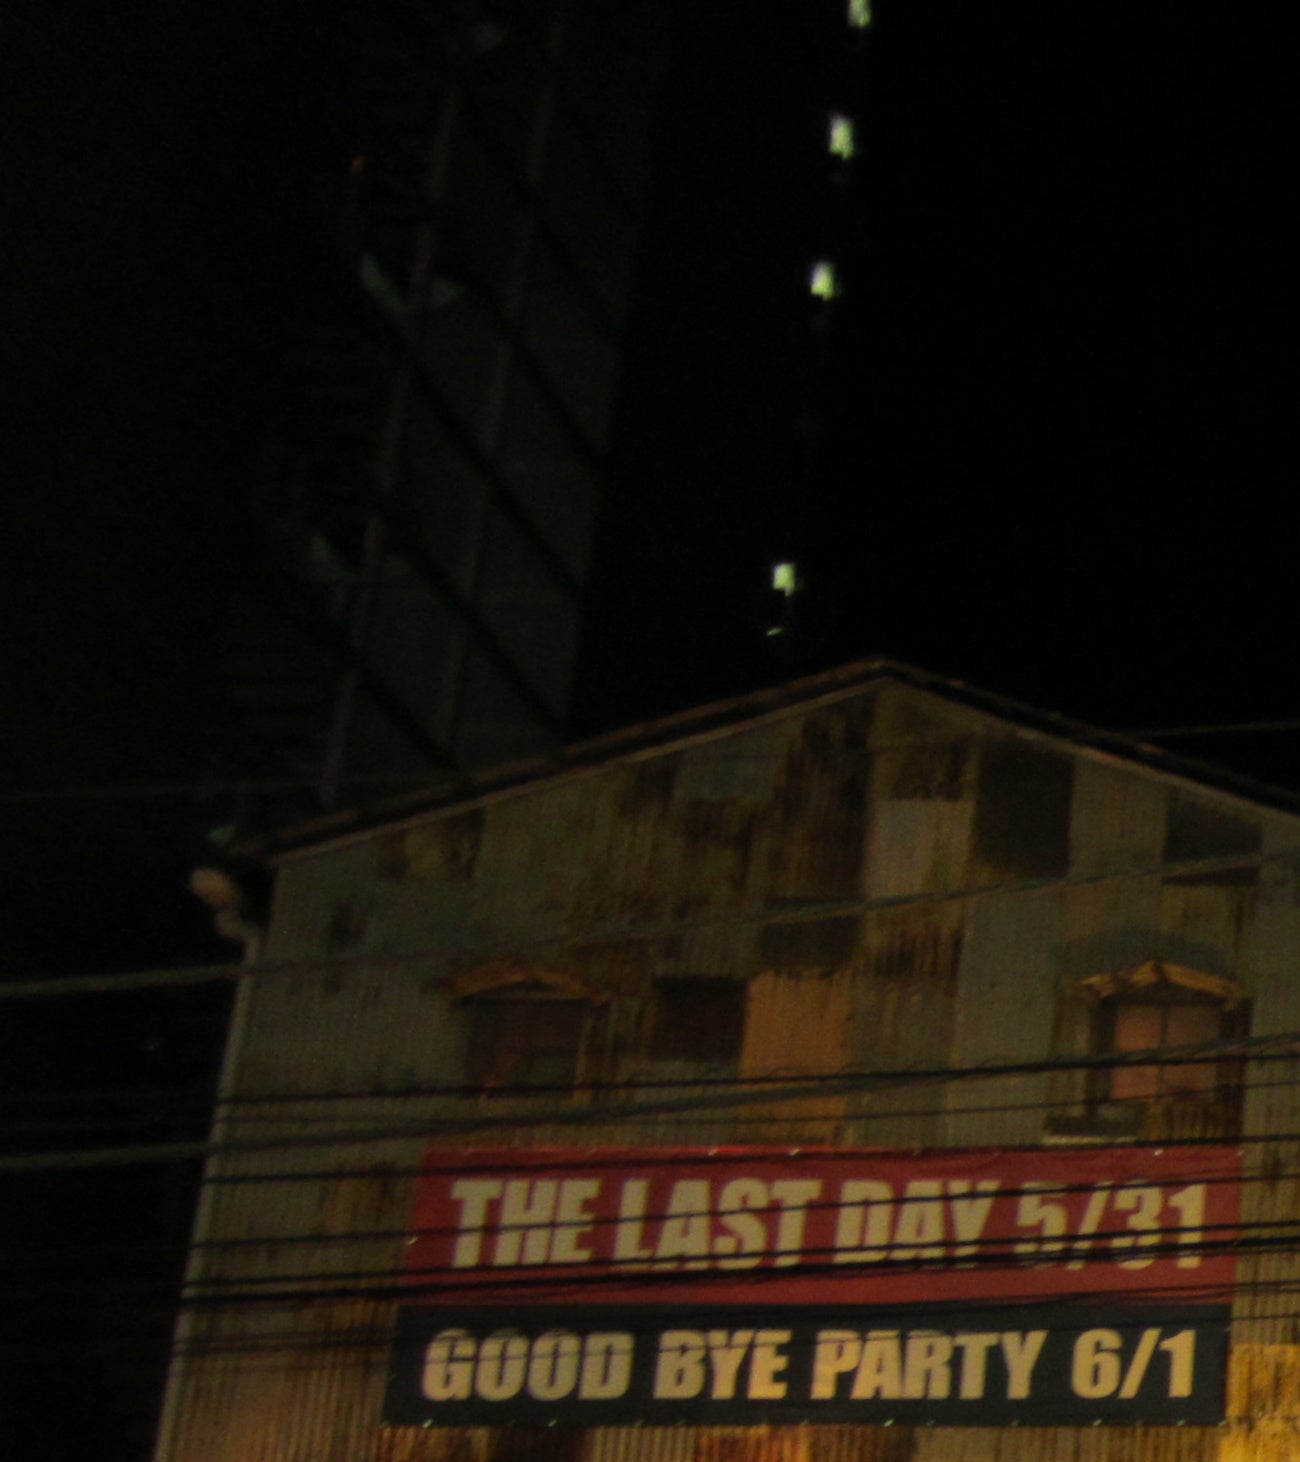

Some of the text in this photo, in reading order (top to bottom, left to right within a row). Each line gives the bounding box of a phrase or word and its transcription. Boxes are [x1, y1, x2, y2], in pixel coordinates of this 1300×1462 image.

[450, 1178, 1208, 1271] THE LAST DAY 5/31
[421, 1328, 1199, 1402] GOOD BYE PARTY 6/1
